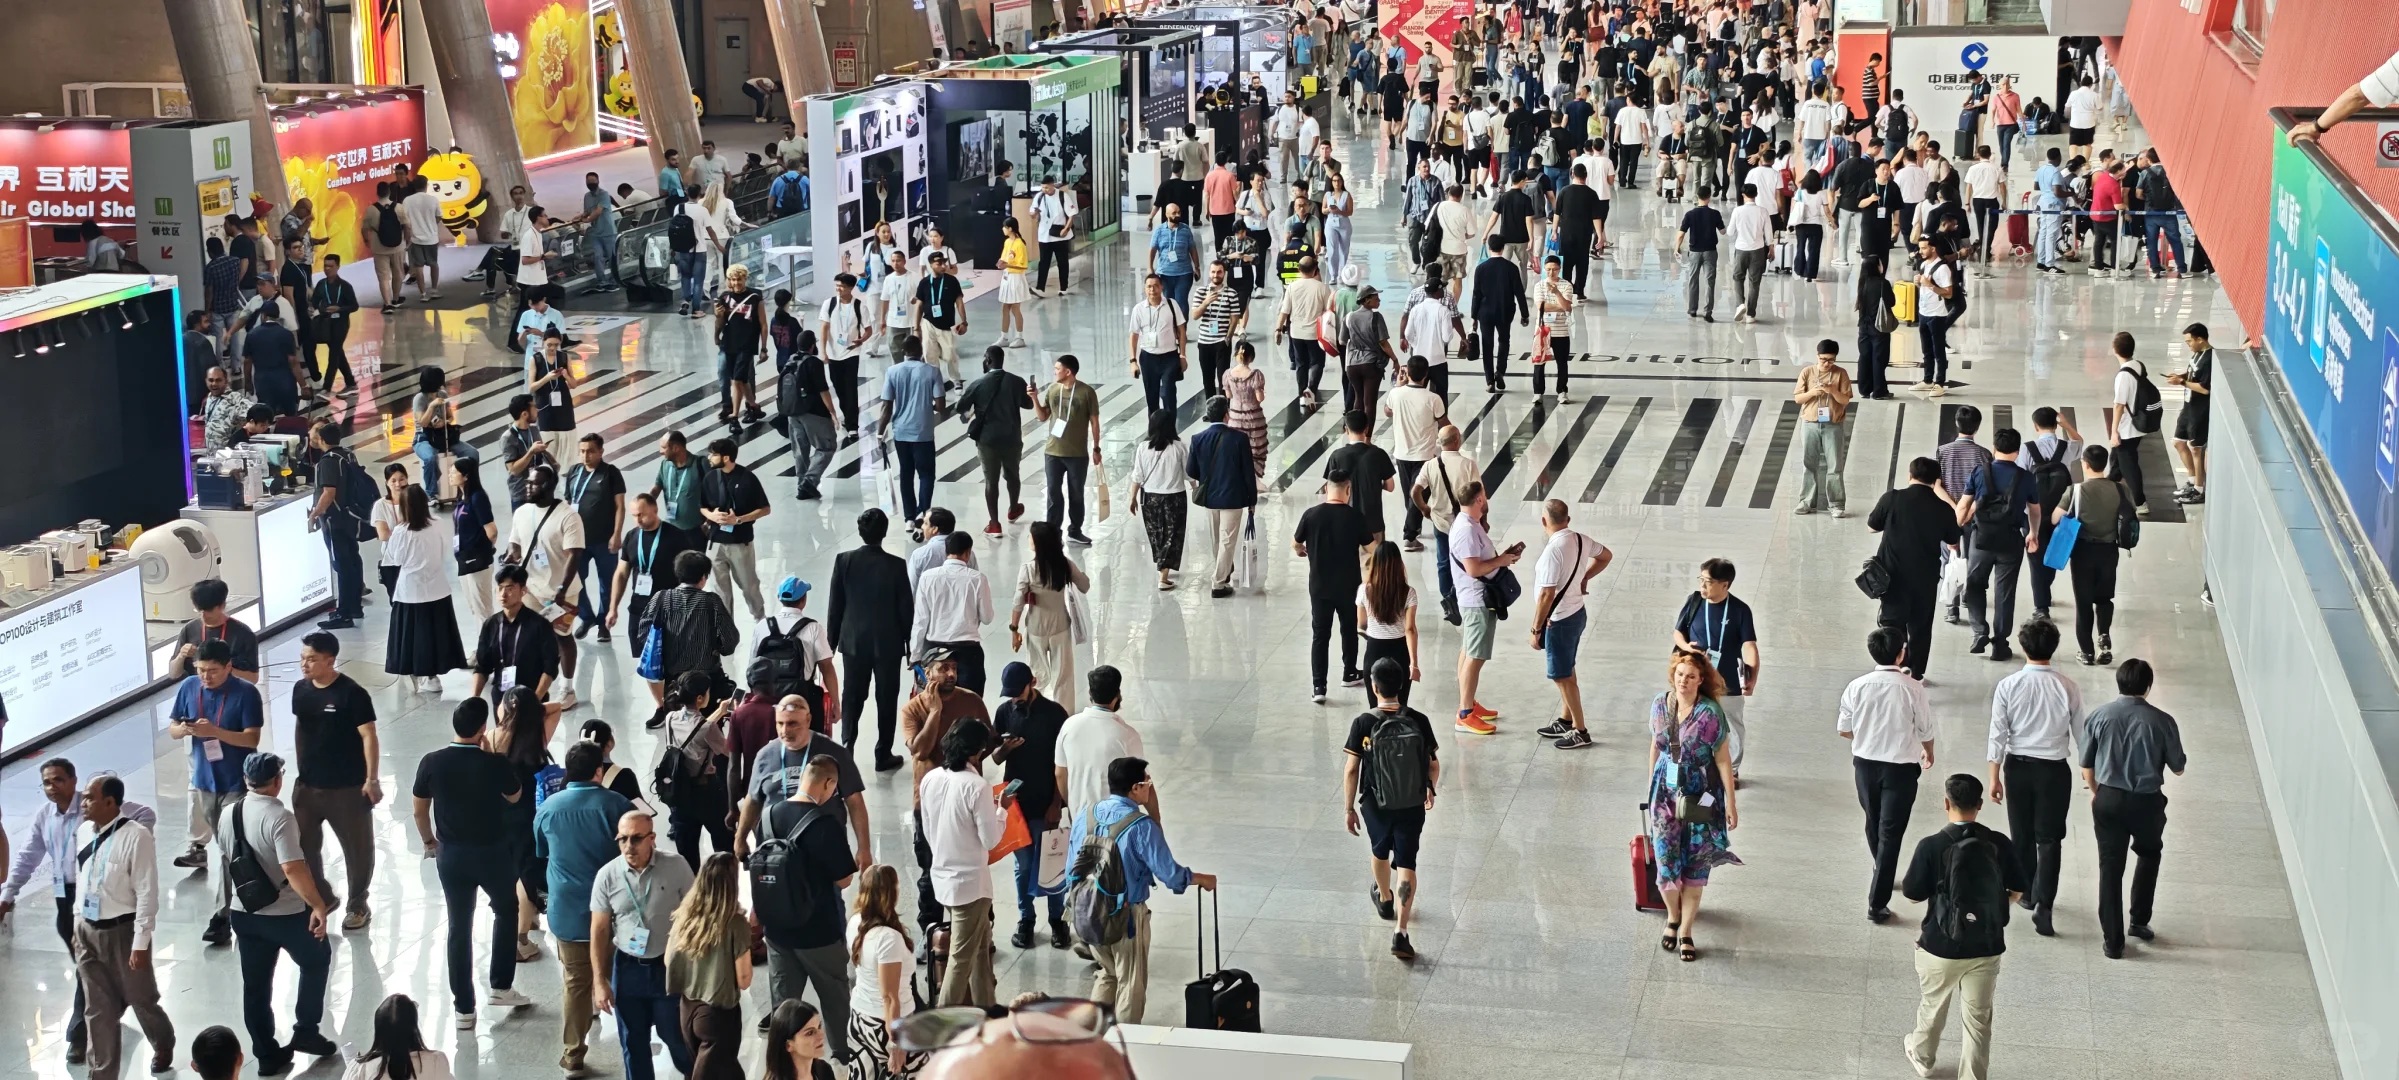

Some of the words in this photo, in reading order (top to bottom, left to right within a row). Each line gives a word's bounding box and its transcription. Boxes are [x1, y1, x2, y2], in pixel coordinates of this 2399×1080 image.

[1928, 73, 2020, 84] 中国建银行
[326, 147, 367, 172] 广交世界
[371, 138, 412, 162] 互利天下
[36, 165, 130, 192] 互利天
[326, 174, 352, 189] Canton
[352, 171, 367, 184] Fair
[369, 165, 392, 179] Global
[28, 200, 95, 217] Global
